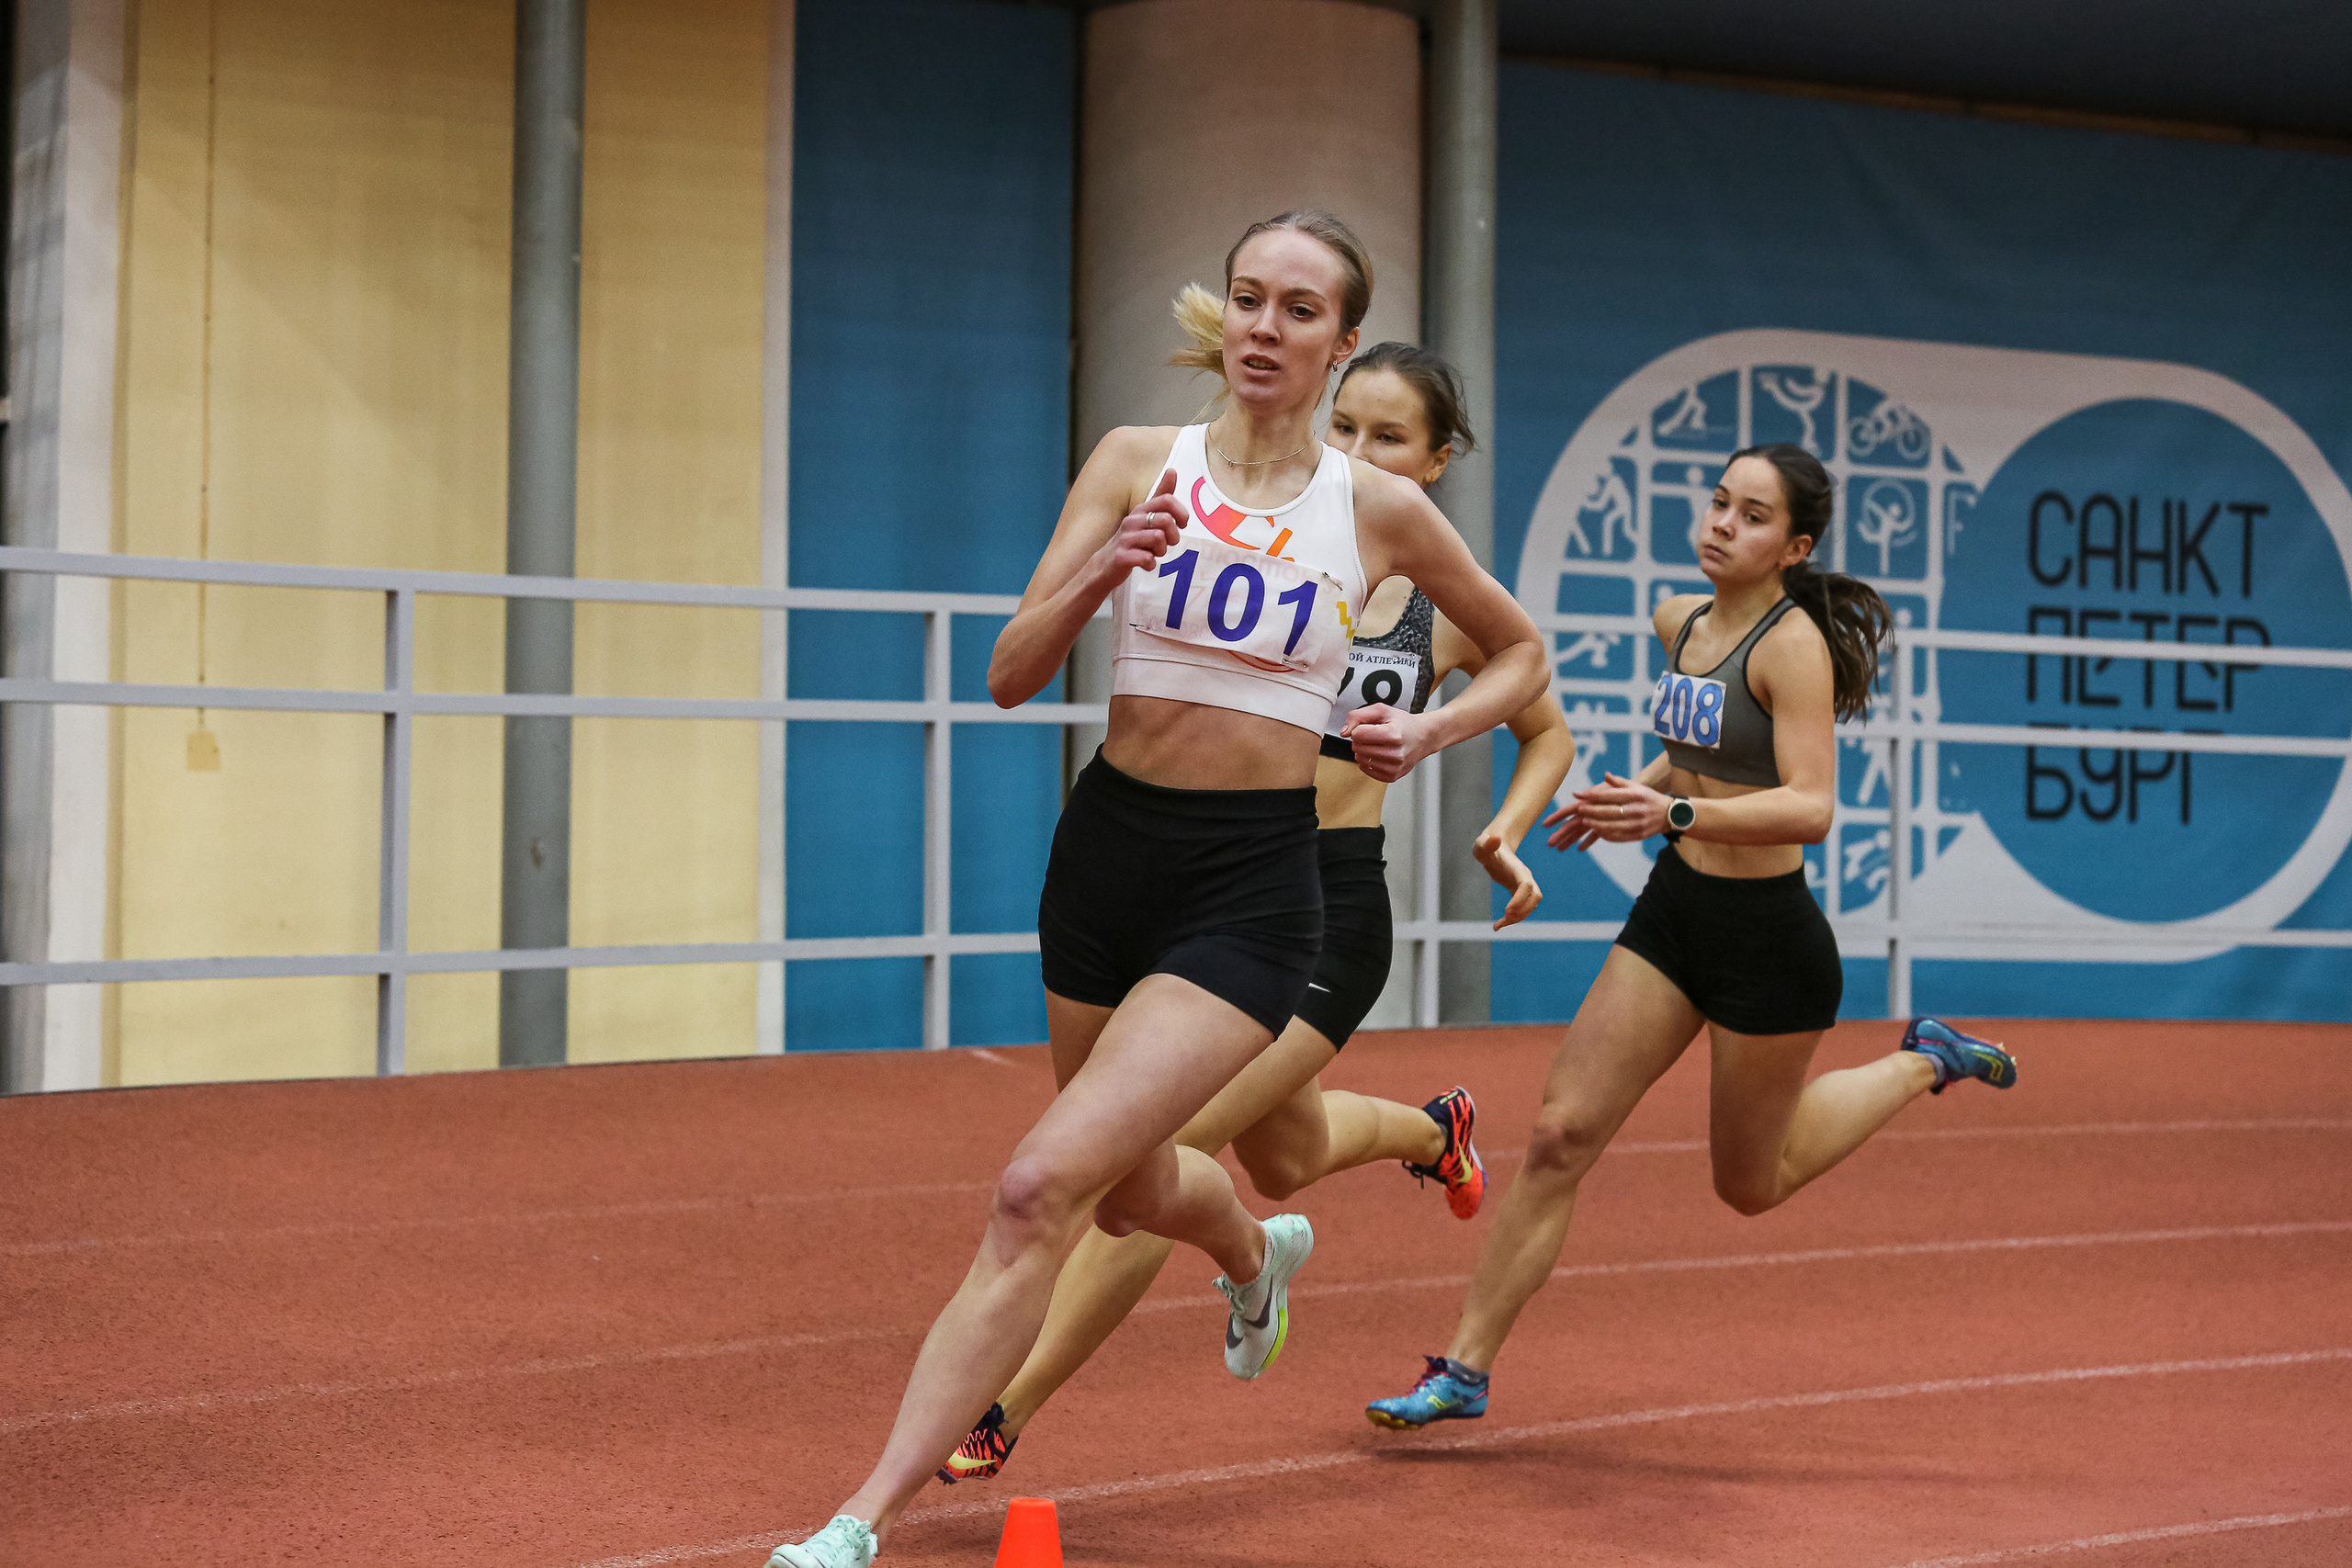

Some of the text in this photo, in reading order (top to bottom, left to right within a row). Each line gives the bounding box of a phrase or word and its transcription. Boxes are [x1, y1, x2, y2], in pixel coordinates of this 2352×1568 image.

[2028, 490, 2269, 599] САНКТ
[1159, 548, 1318, 657] 101
[1655, 674, 1723, 746] 208
[2027, 605, 2271, 713] ПЕТЕР
